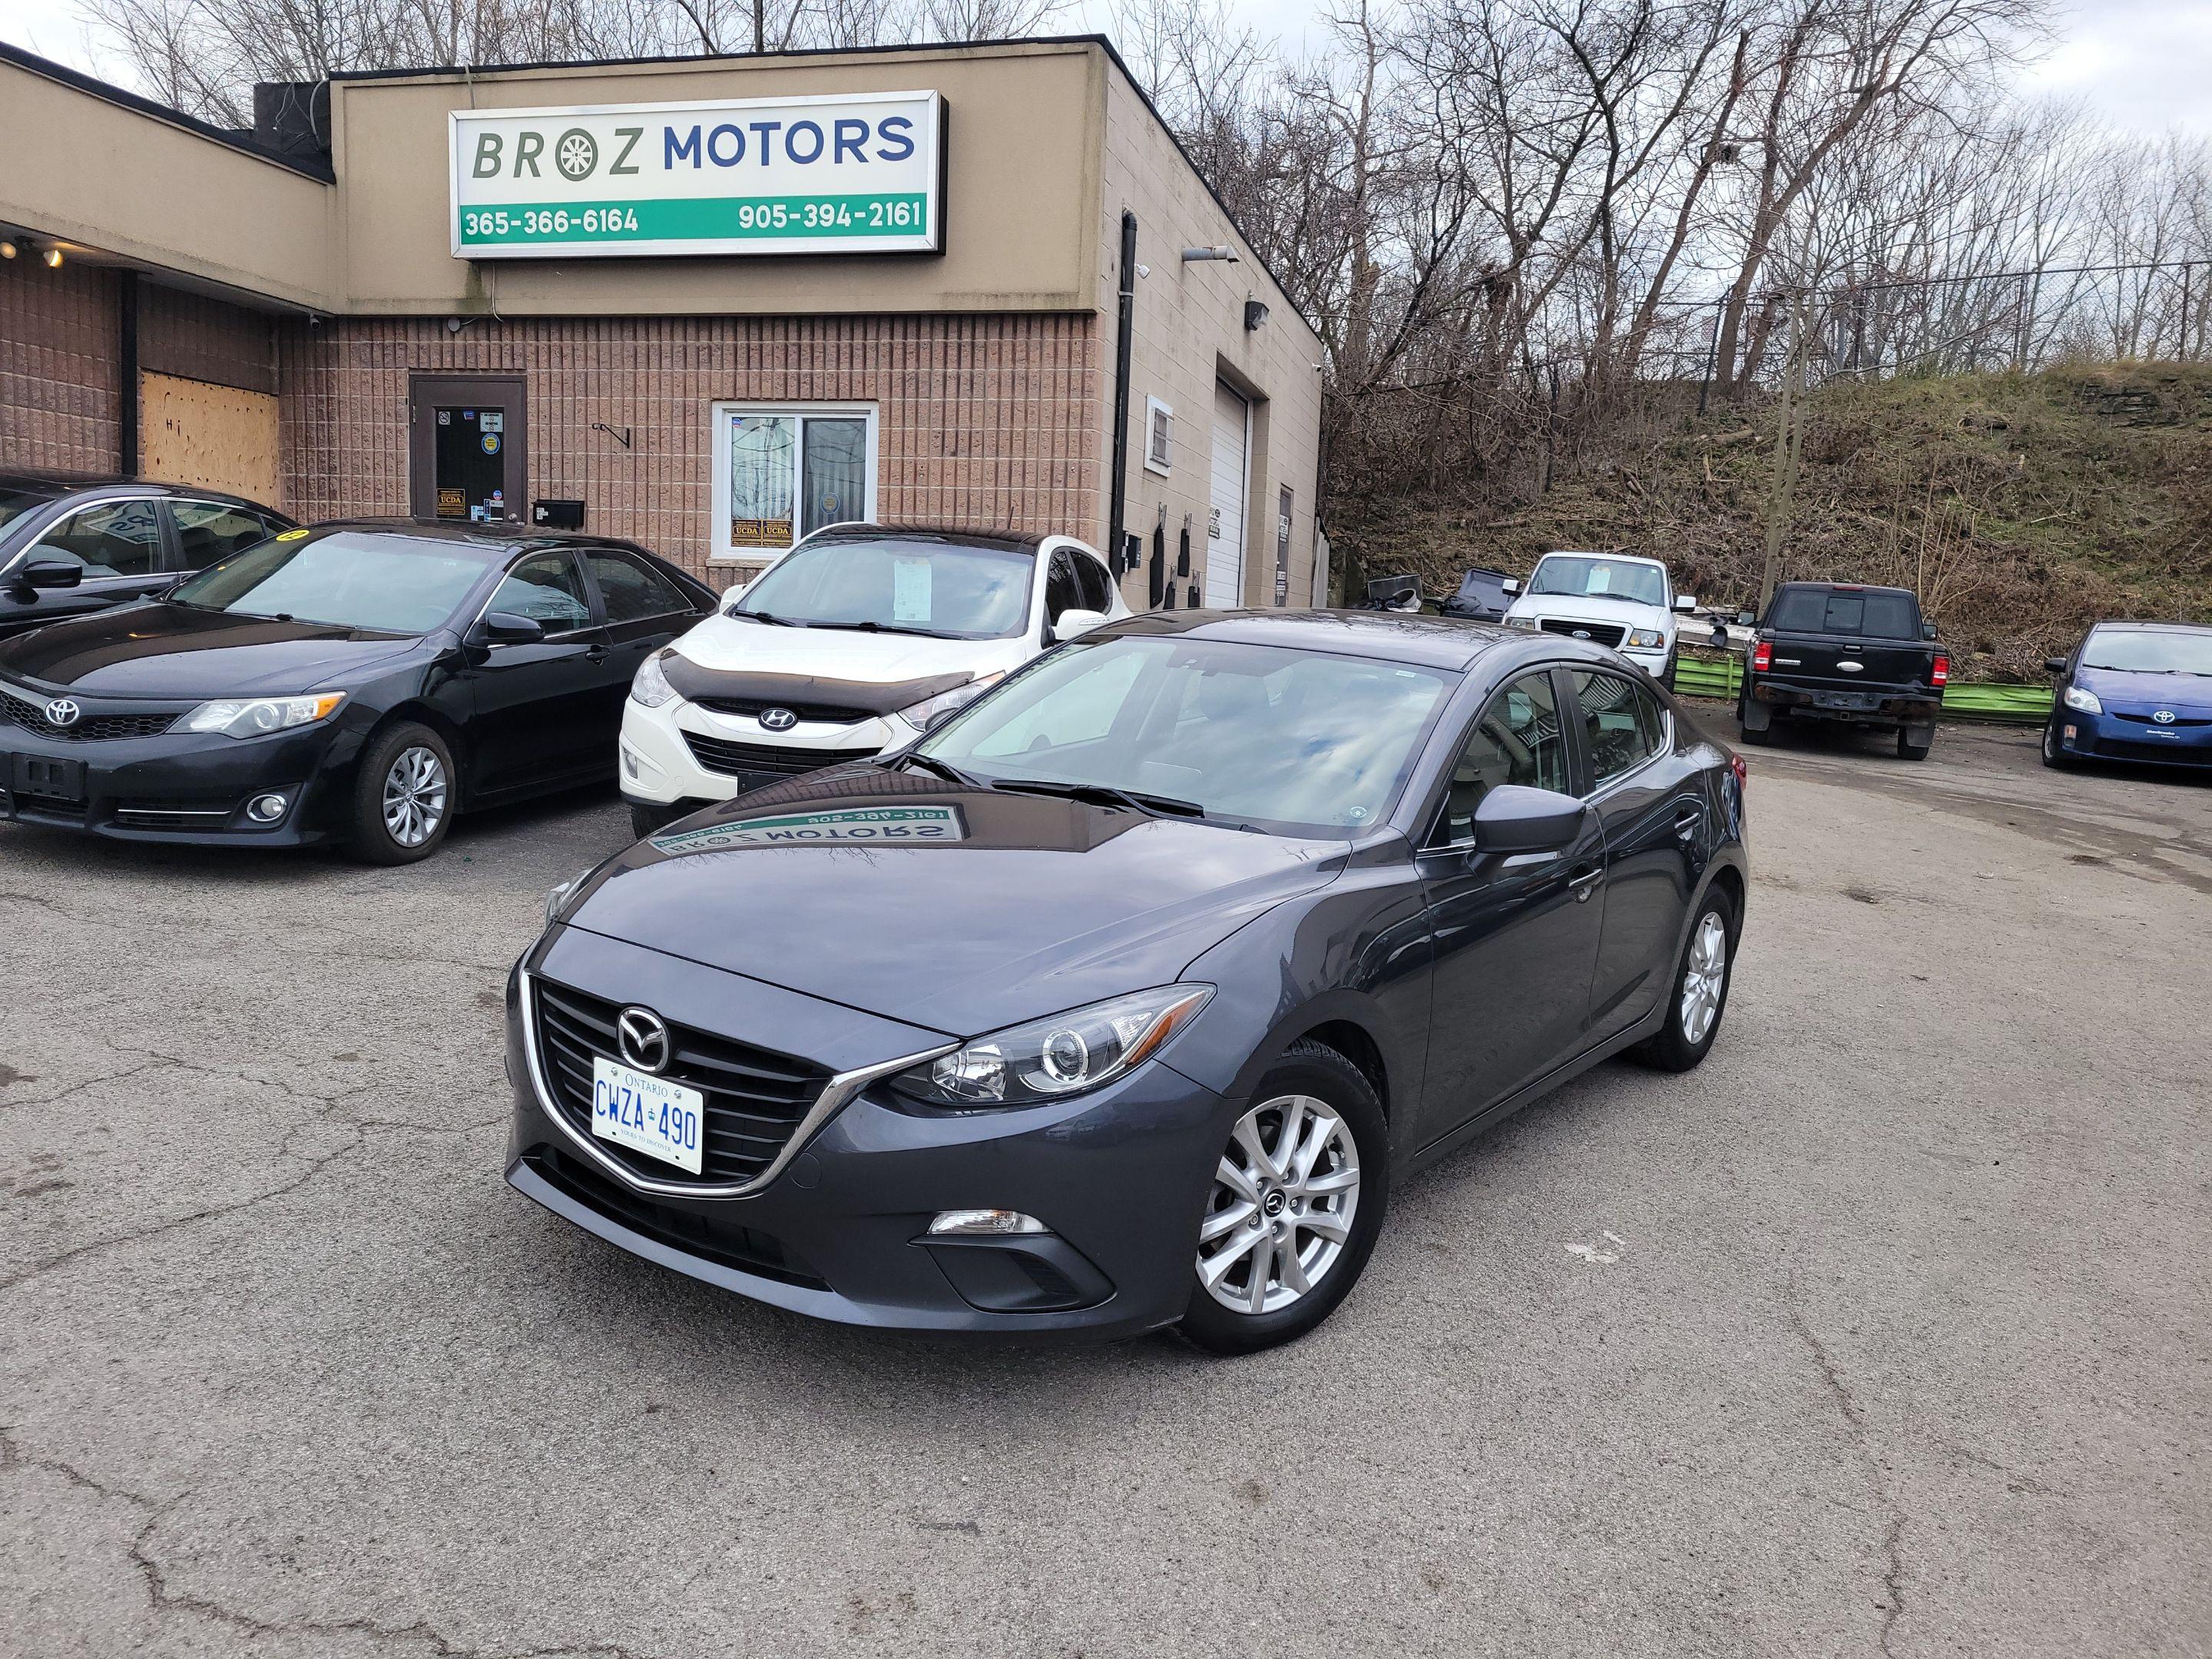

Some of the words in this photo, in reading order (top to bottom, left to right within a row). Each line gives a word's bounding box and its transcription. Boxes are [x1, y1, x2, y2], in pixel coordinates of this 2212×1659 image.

[472, 127, 644, 182] BROZ
[663, 116, 915, 171] MOTORS
[465, 207, 639, 236] 365-366-6164
[738, 200, 921, 229] 905-394-2161
[624, 1073, 668, 1098] ONTARIO
[595, 1080, 644, 1131] CWZA
[658, 1102, 696, 1150] 490
[621, 1128, 637, 1139] YOURS
[647, 1138, 671, 1152] DISCOVER
